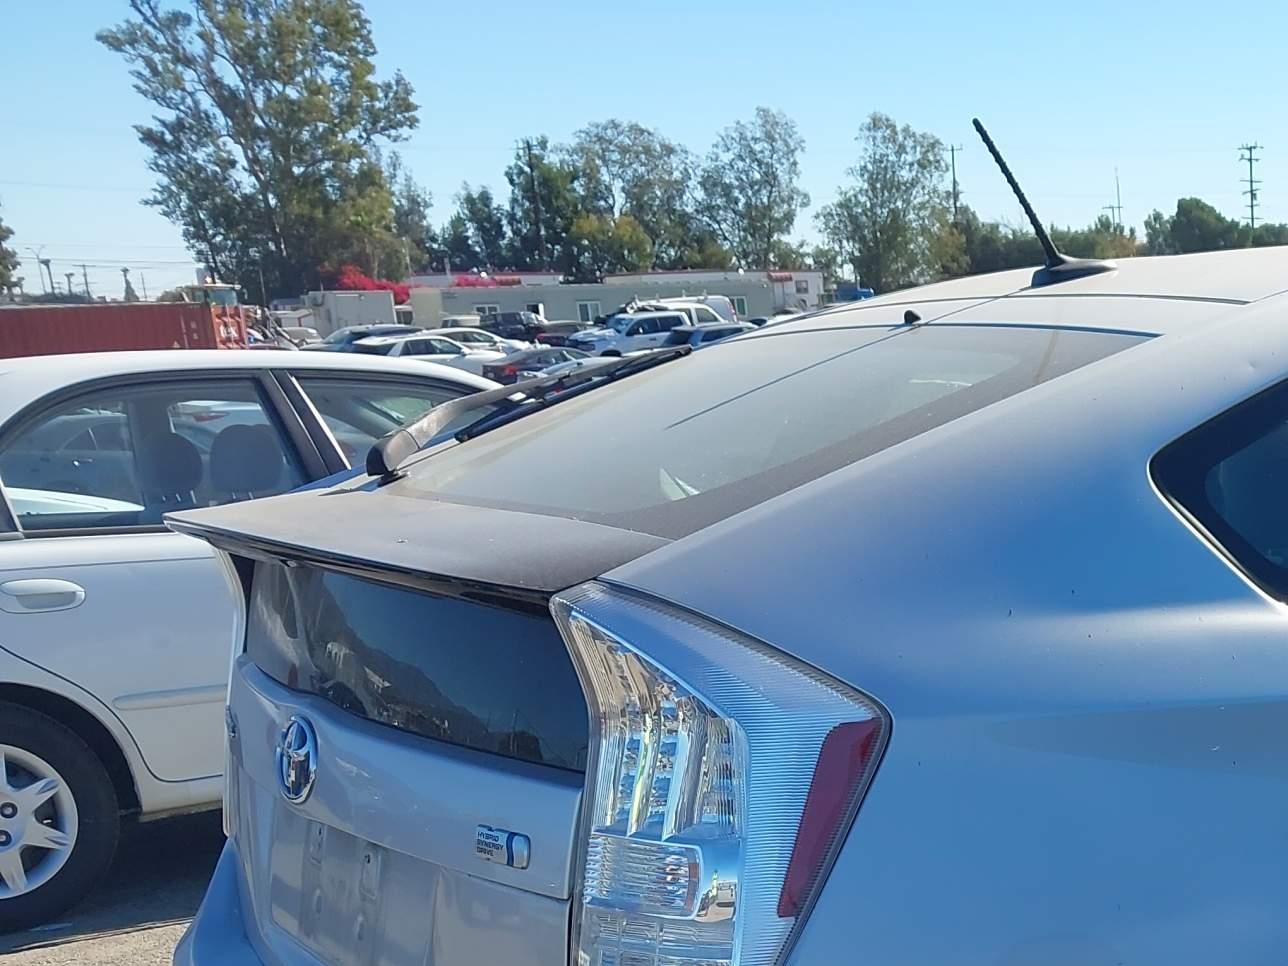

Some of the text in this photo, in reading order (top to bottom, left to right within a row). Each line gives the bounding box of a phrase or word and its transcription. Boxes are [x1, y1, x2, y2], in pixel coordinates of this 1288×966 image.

[477, 831, 500, 842] HYBRID
[477, 838, 504, 851] SYNERGY
[476, 846, 495, 857] DRIVE
